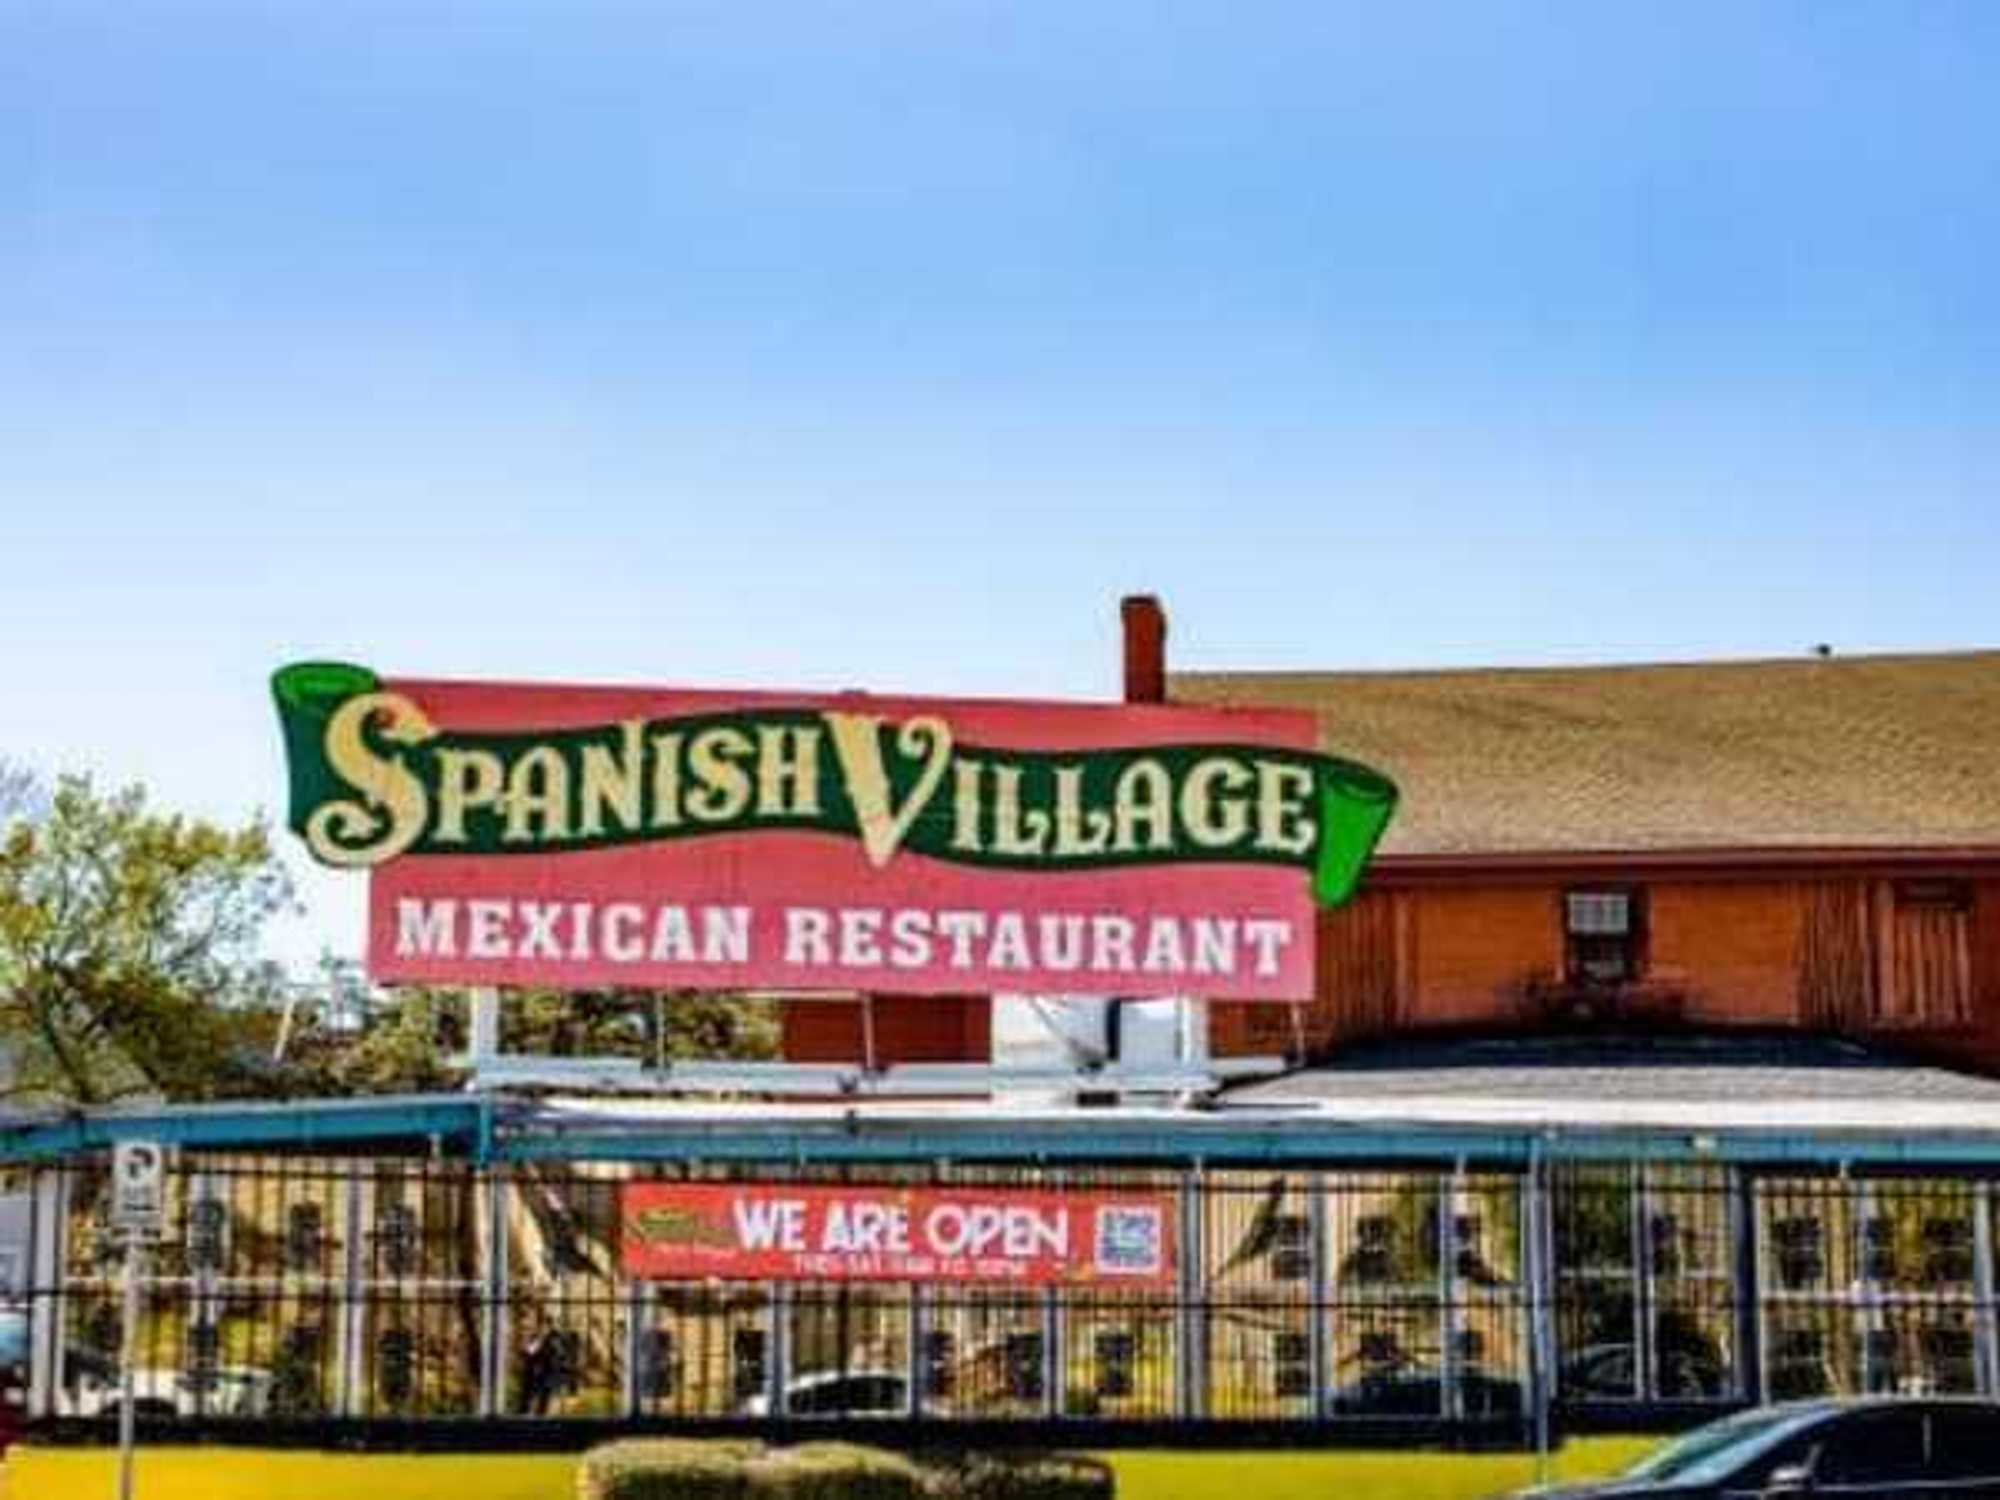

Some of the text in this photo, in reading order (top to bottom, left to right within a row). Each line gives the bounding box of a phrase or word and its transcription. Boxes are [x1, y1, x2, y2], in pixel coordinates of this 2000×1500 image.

[306, 693, 1317, 866] SPANISH VILLAGE
[396, 897, 1292, 974] MEXICAN RESTAURANT
[732, 1199, 808, 1252] WE
[822, 1199, 911, 1253] ARE
[925, 1204, 1068, 1256] OPEN
